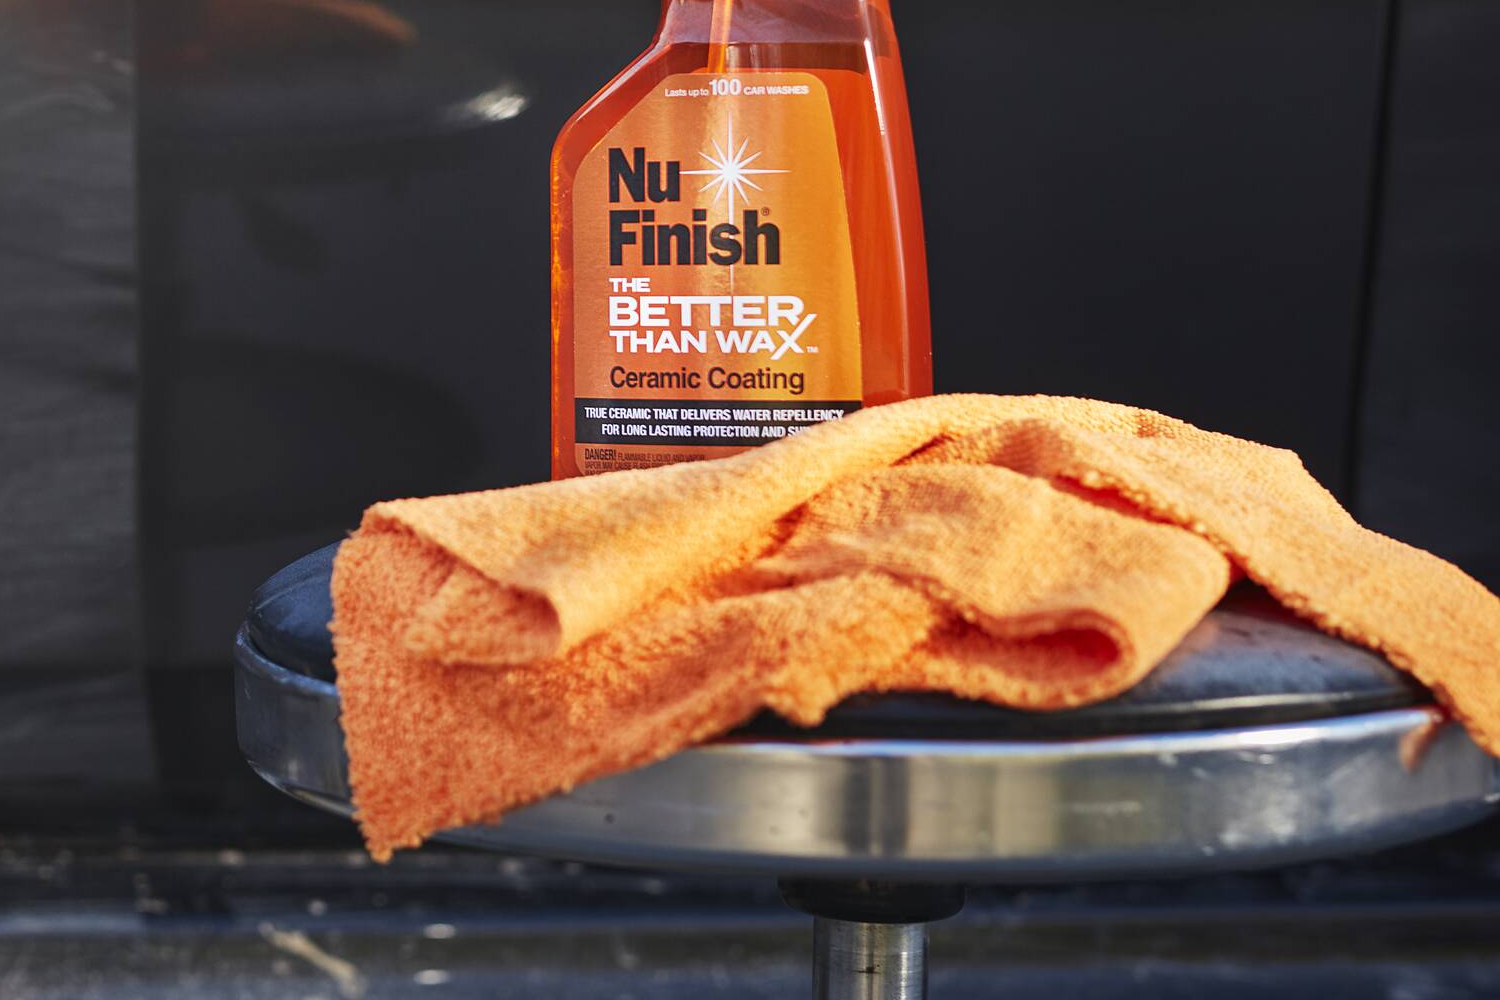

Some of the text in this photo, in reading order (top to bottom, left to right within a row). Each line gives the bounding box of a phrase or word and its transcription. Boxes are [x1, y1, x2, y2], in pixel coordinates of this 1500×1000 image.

[664, 88, 687, 97] Lasts
[708, 78, 741, 96] 100
[743, 86, 765, 96] CAR
[766, 85, 809, 95] WASHES
[608, 147, 680, 203] Nu
[609, 277, 650, 293] THE
[608, 295, 805, 327] BETTER
[609, 313, 817, 360] THAN WAX
[610, 365, 805, 395] Ceramic Coating
[584, 407, 844, 421] TRUE CERAMIC THAT DELIVERS WATER REPELLENCY
[601, 423, 620, 435] FOR
[621, 424, 647, 436] LONG
[649, 424, 692, 437] LASTING
[693, 425, 759, 438] PROTECTION
[761, 426, 786, 438] AND
[584, 448, 617, 460] DANGER!
